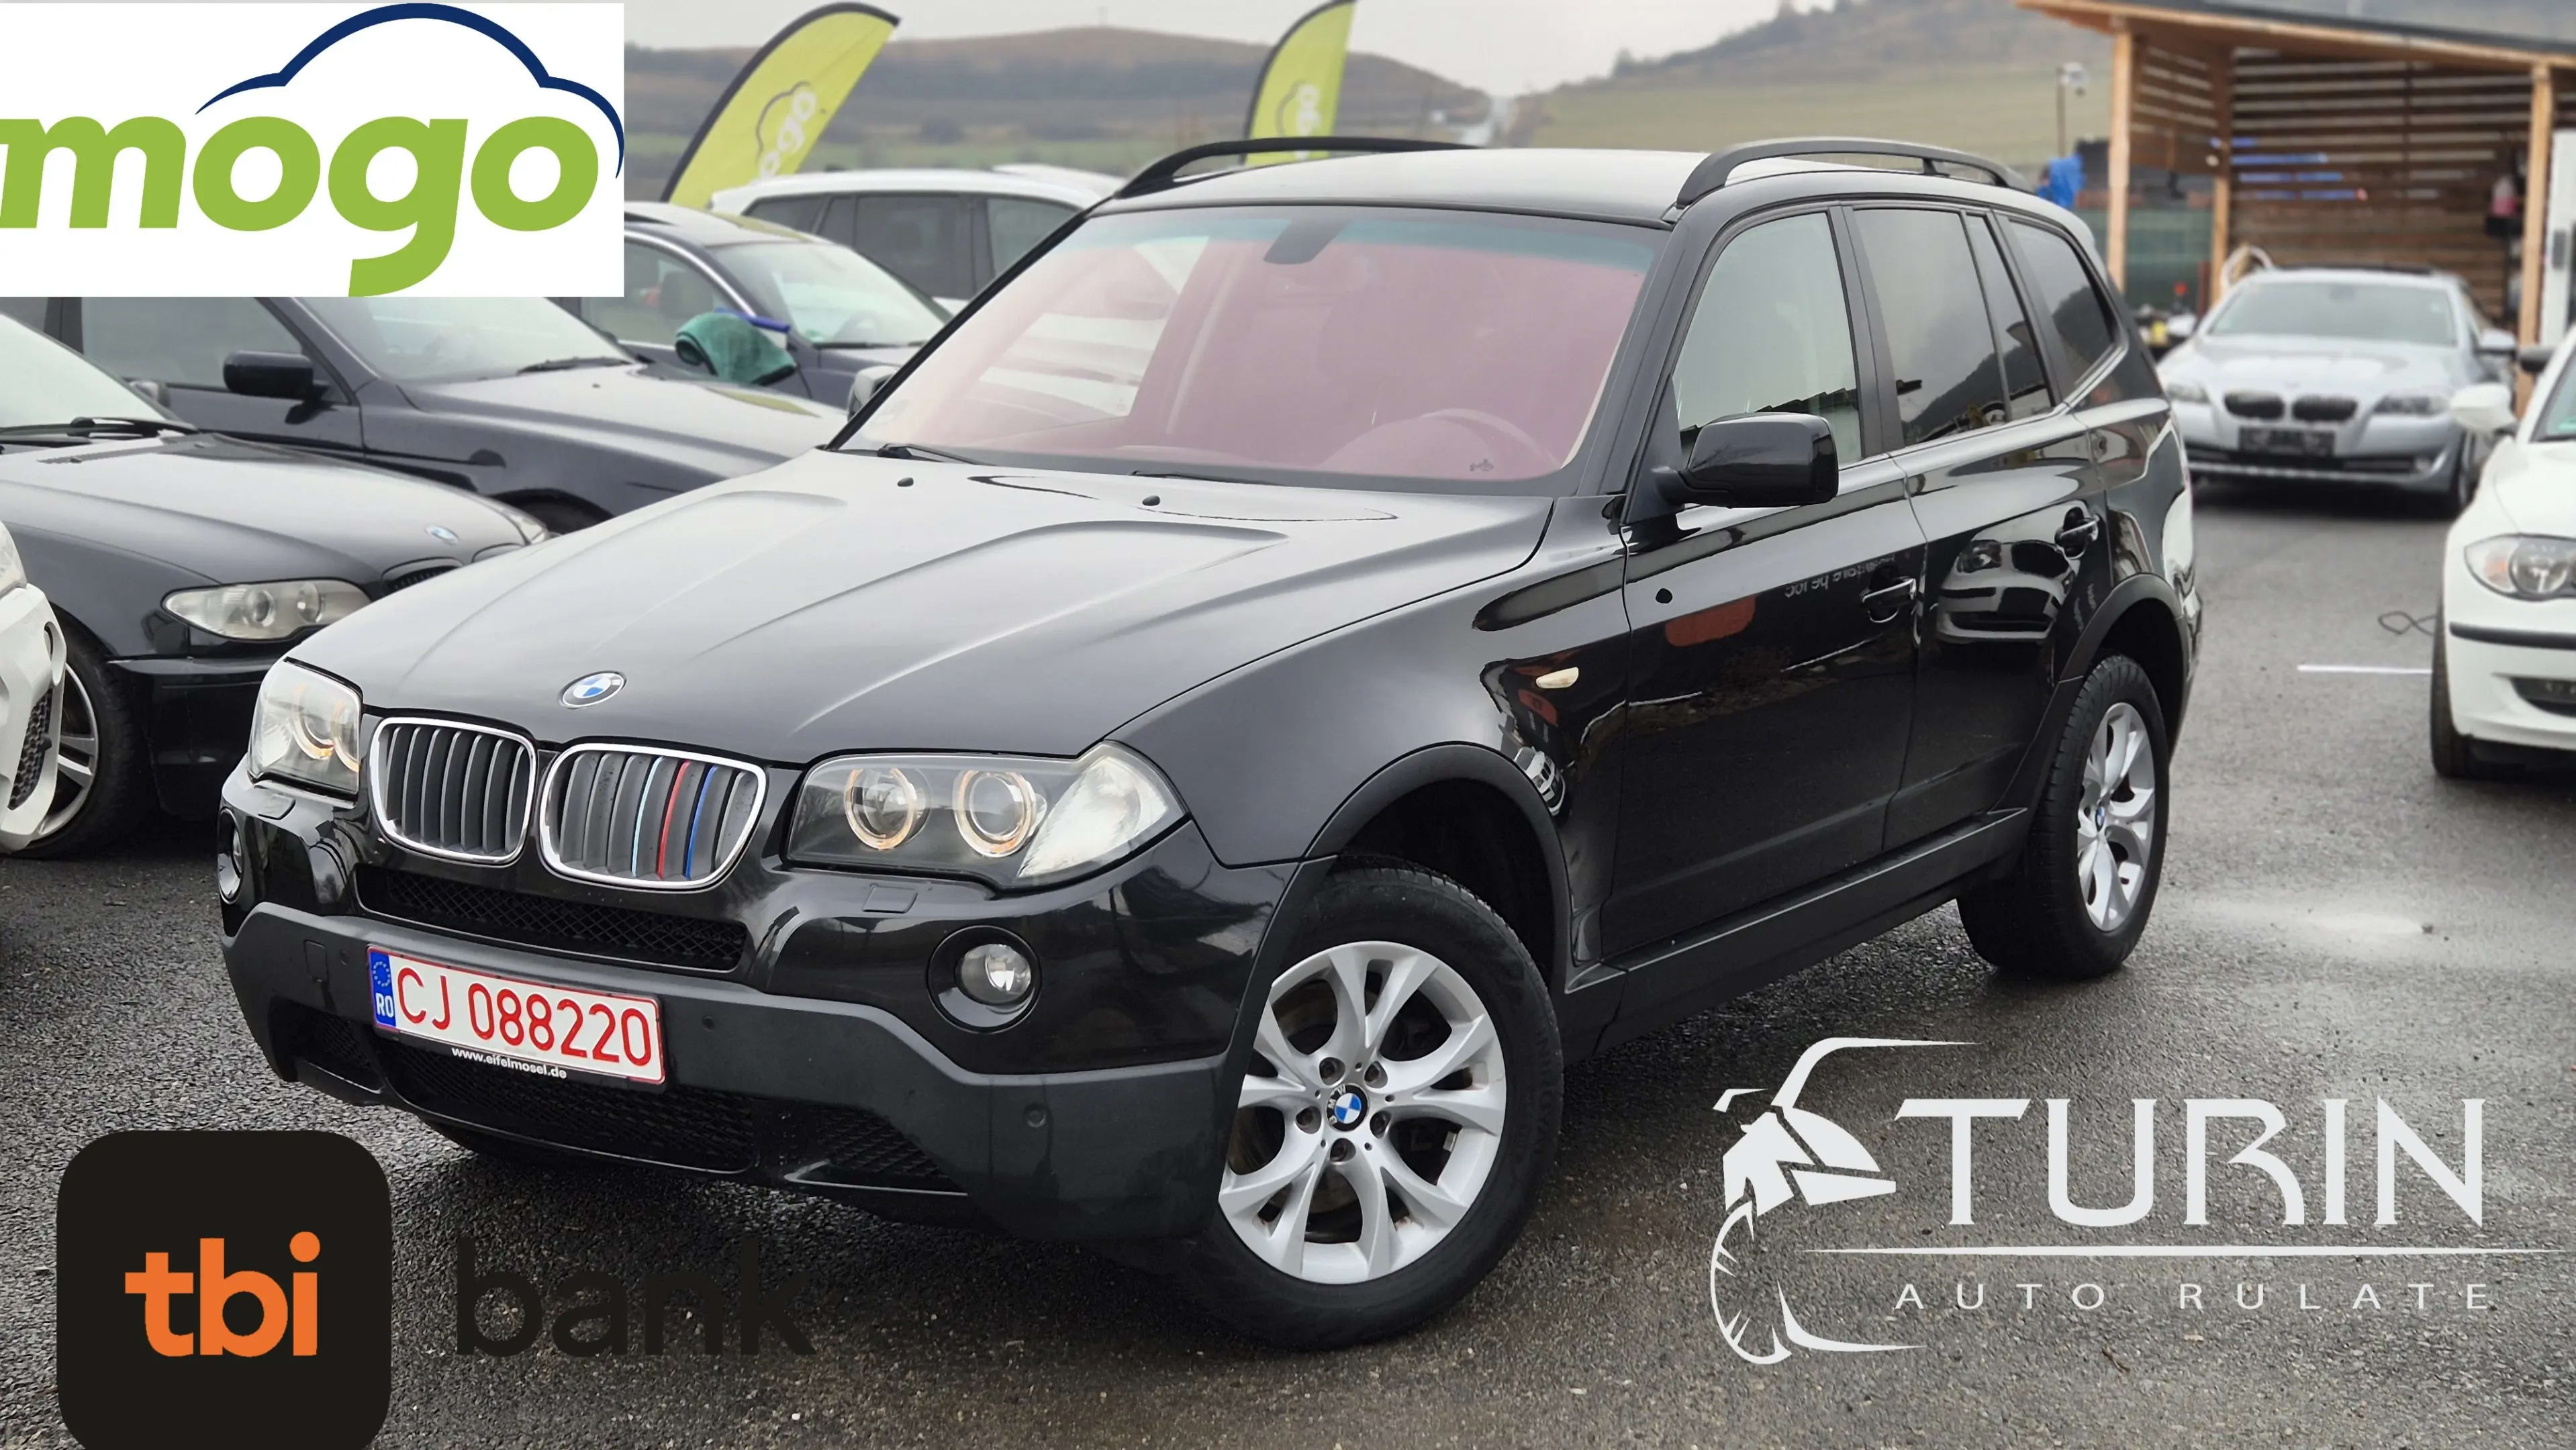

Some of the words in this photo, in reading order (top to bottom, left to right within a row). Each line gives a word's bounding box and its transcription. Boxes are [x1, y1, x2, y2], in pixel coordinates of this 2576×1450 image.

[375, 992, 395, 1018] RO
[397, 967, 450, 1030] CJ
[468, 983, 652, 1067] 088220
[451, 1047, 567, 1079] www.eifelmosel.de
[1327, 1084, 1346, 1126] BMW
